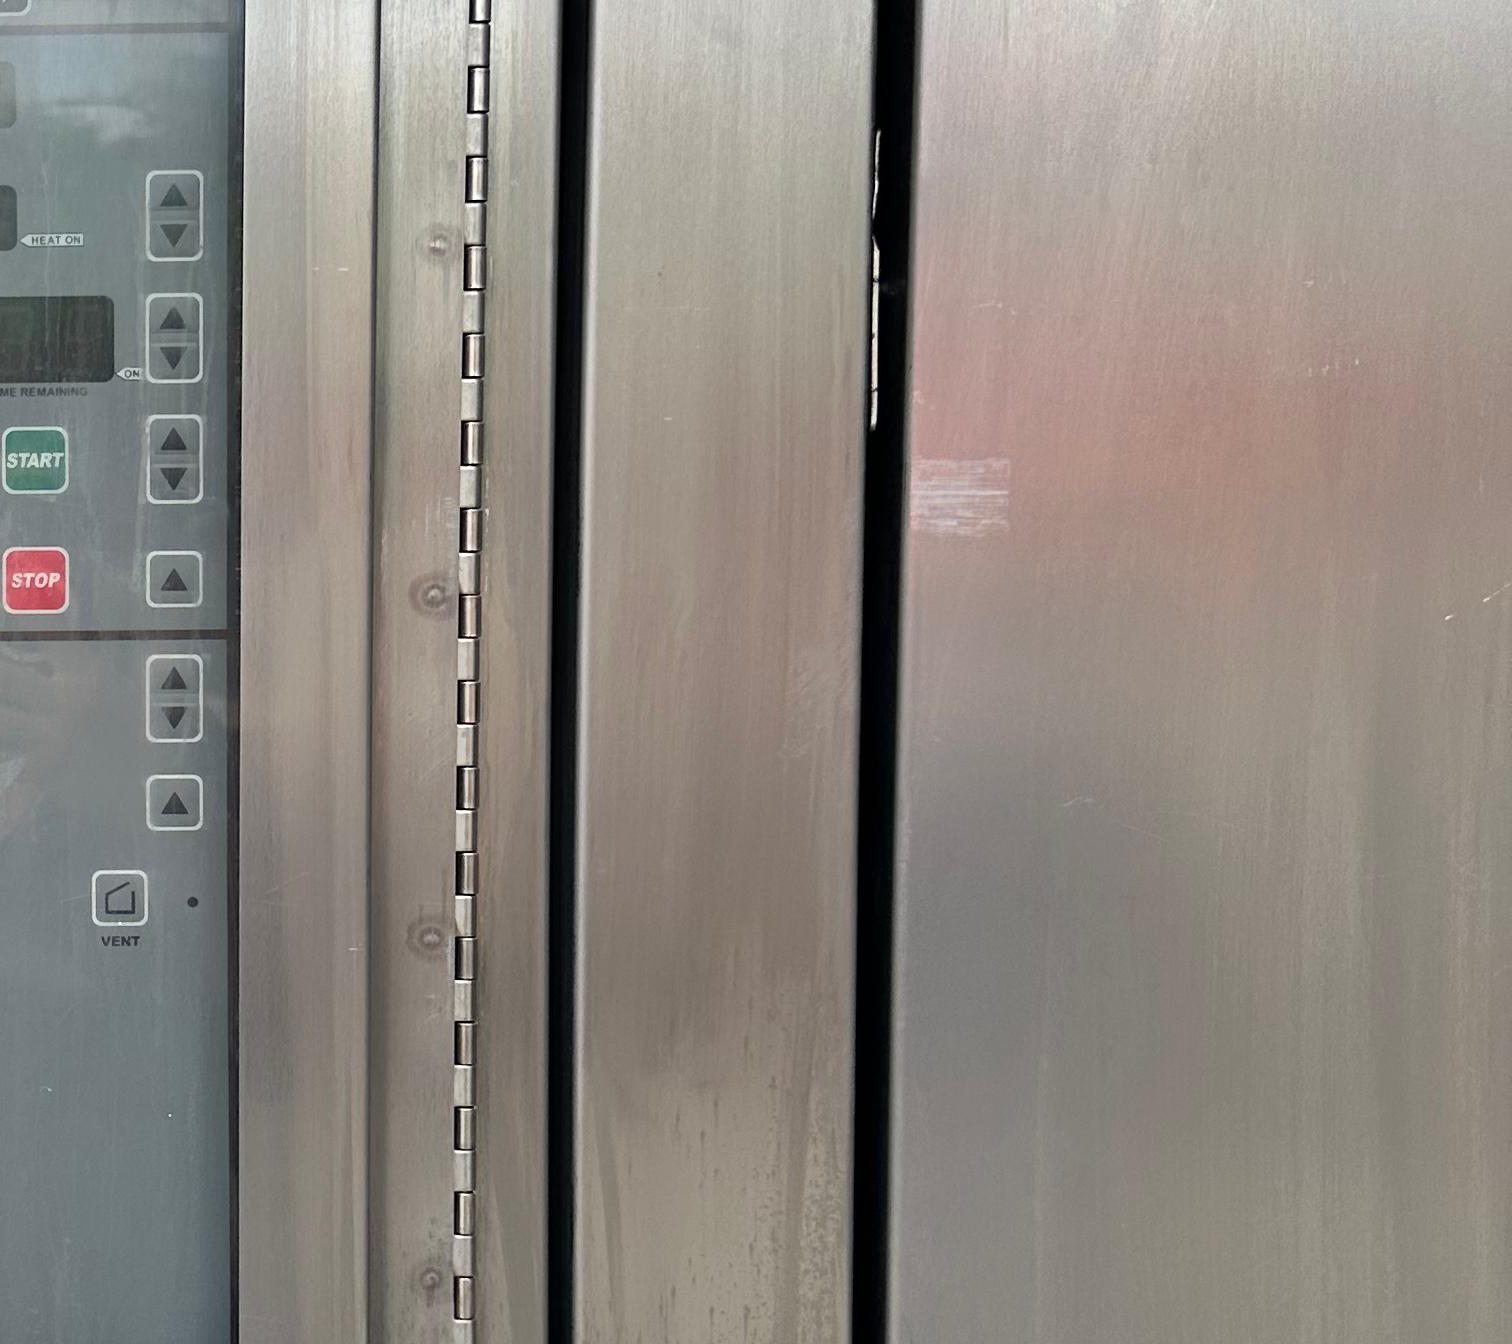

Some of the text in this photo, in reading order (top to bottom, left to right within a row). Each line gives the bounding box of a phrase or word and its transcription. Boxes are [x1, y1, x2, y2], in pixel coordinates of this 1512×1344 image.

[31, 235, 81, 246] HEAT ON
[123, 368, 140, 379] ON
[20, 387, 88, 399] REMAINING
[6, 451, 64, 470] START
[11, 572, 61, 590] STOP
[101, 935, 140, 948] VENT
